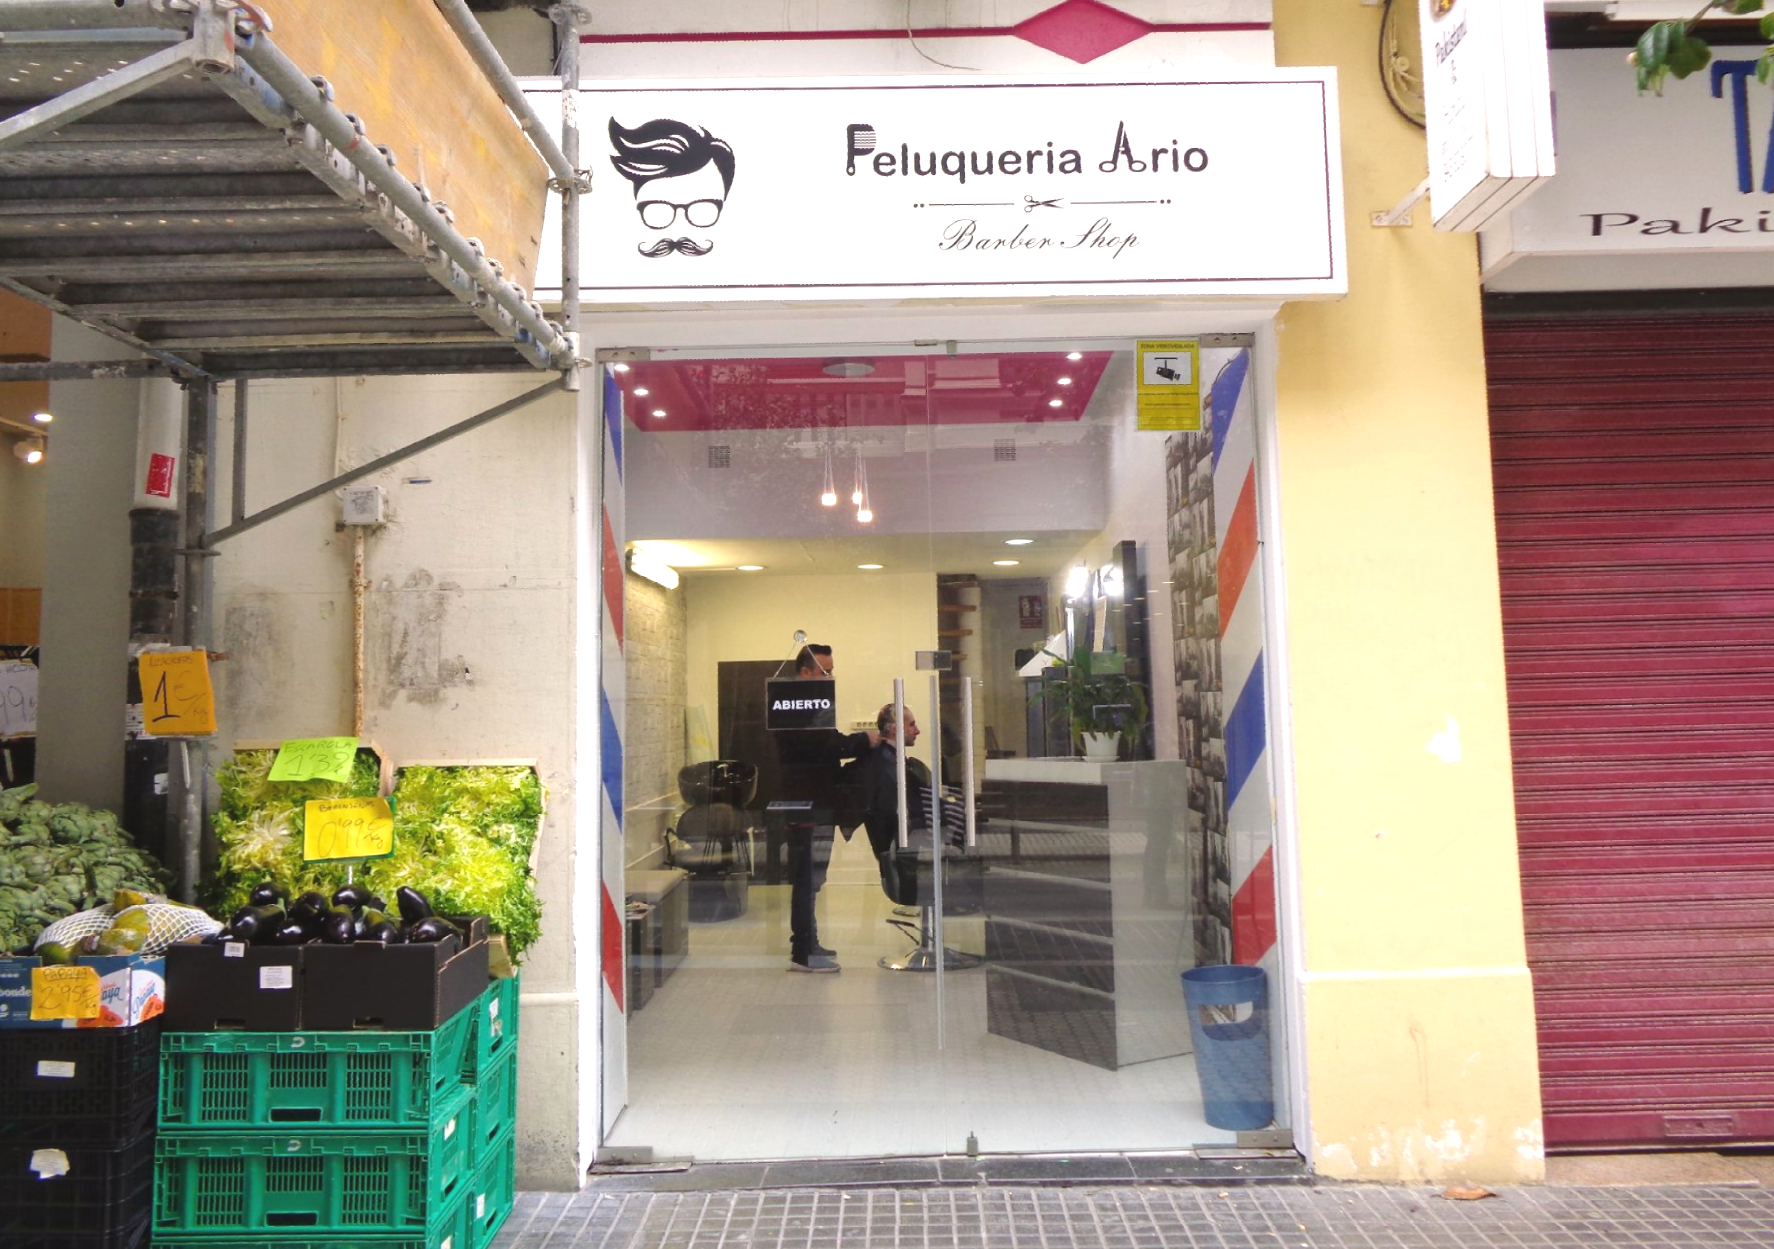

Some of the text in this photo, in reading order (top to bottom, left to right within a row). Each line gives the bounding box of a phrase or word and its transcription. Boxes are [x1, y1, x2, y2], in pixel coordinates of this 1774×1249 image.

[1711, 59, 1774, 195] T
[846, 120, 1209, 184] Peluqueria Ario
[938, 216, 1141, 260] Barber Shop
[772, 698, 831, 711] ABIERTO
[43, 967, 88, 981] PAPAYA
